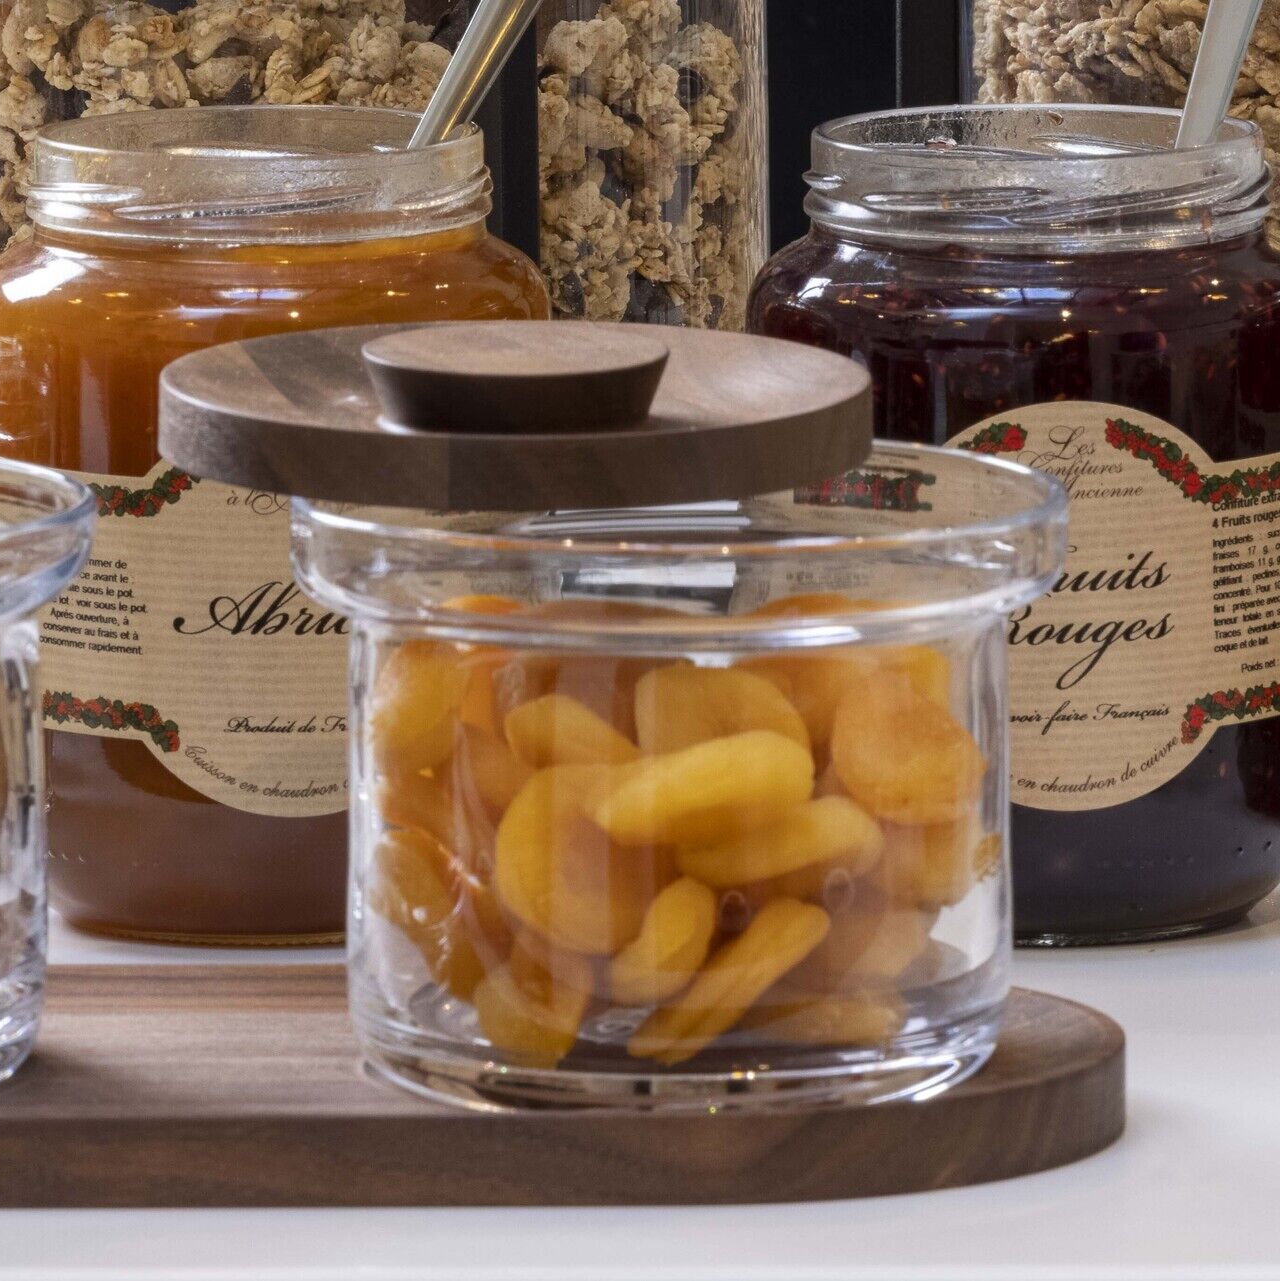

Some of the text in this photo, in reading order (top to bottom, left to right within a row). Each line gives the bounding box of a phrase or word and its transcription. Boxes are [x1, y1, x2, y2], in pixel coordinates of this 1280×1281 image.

[1048, 424, 1096, 460] Les
[1212, 498, 1259, 512] Confiture
[1212, 519, 1219, 529] 4
[1222, 515, 1251, 528] Fruits
[1212, 534, 1254, 549] Ingrédients
[115, 559, 127, 569] de
[1046, 545, 1171, 597] ruits
[1212, 560, 1255, 574] framboises
[93, 572, 118, 583] avant
[120, 574, 129, 583] le
[82, 585, 104, 596] sous
[106, 586, 115, 596] le
[1256, 584, 1271, 593] Pour
[76, 599, 92, 608] voir
[94, 601, 116, 611] sous
[118, 601, 128, 611] le
[50, 607, 130, 626] Après ouverture, à
[1265, 609, 1274, 618] en
[43, 621, 139, 641] conserver au frais et à
[1215, 629, 1242, 639] Traces
[1214, 638, 1257, 654] coque et de
[1241, 662, 1263, 673] Poids
[1264, 658, 1276, 670] net
[224, 715, 295, 733] Produit
[297, 715, 316, 733] de
[1009, 700, 1169, 736] voir-faire Français
[185, 745, 237, 786] Cuisson
[239, 781, 260, 793] en
[263, 780, 340, 798] chaudron
[1017, 736, 1178, 793] en chaudron de cuivre
